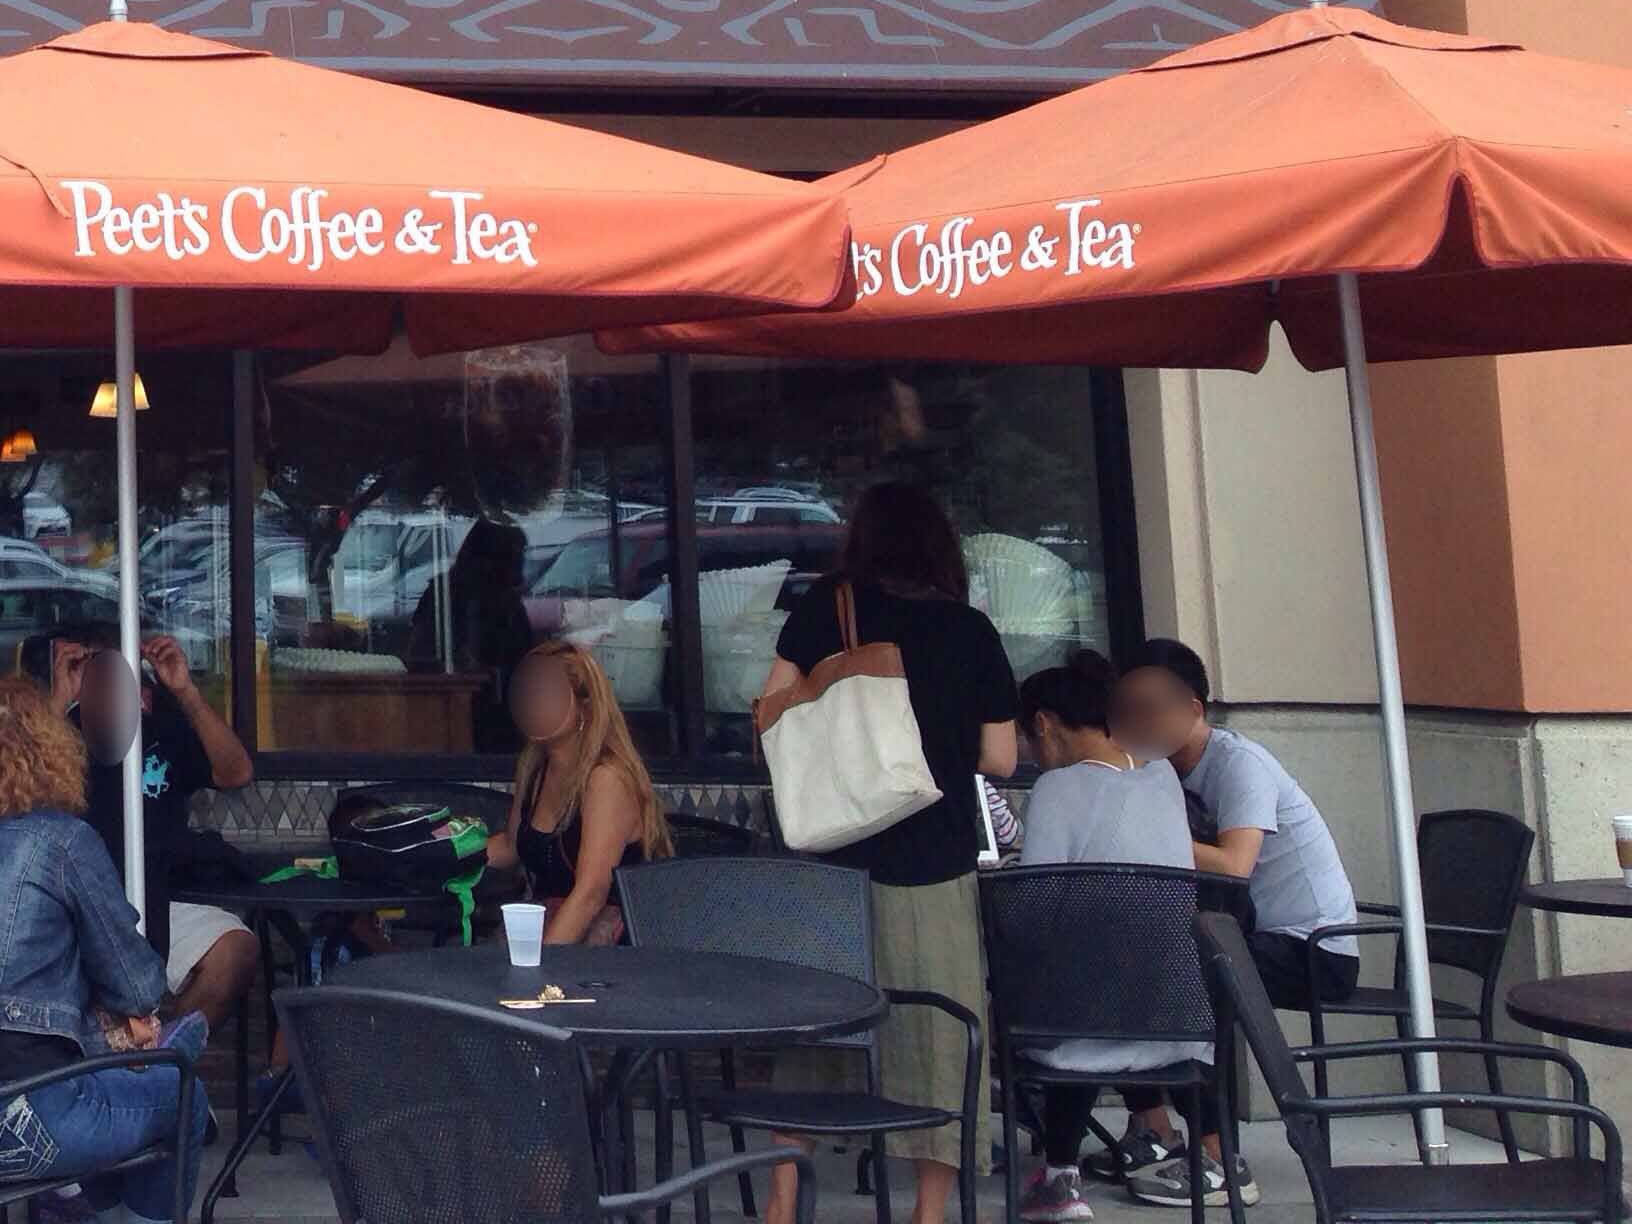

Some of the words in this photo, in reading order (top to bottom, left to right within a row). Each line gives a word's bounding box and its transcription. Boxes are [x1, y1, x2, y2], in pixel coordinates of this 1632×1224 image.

[60, 180, 210, 260] Peet's
[221, 186, 385, 271] Coffee
[395, 208, 441, 254] &
[429, 190, 539, 267] Tea
[891, 216, 1014, 299] Coffee
[1020, 225, 1060, 272] &
[1056, 199, 1136, 276] Tea
